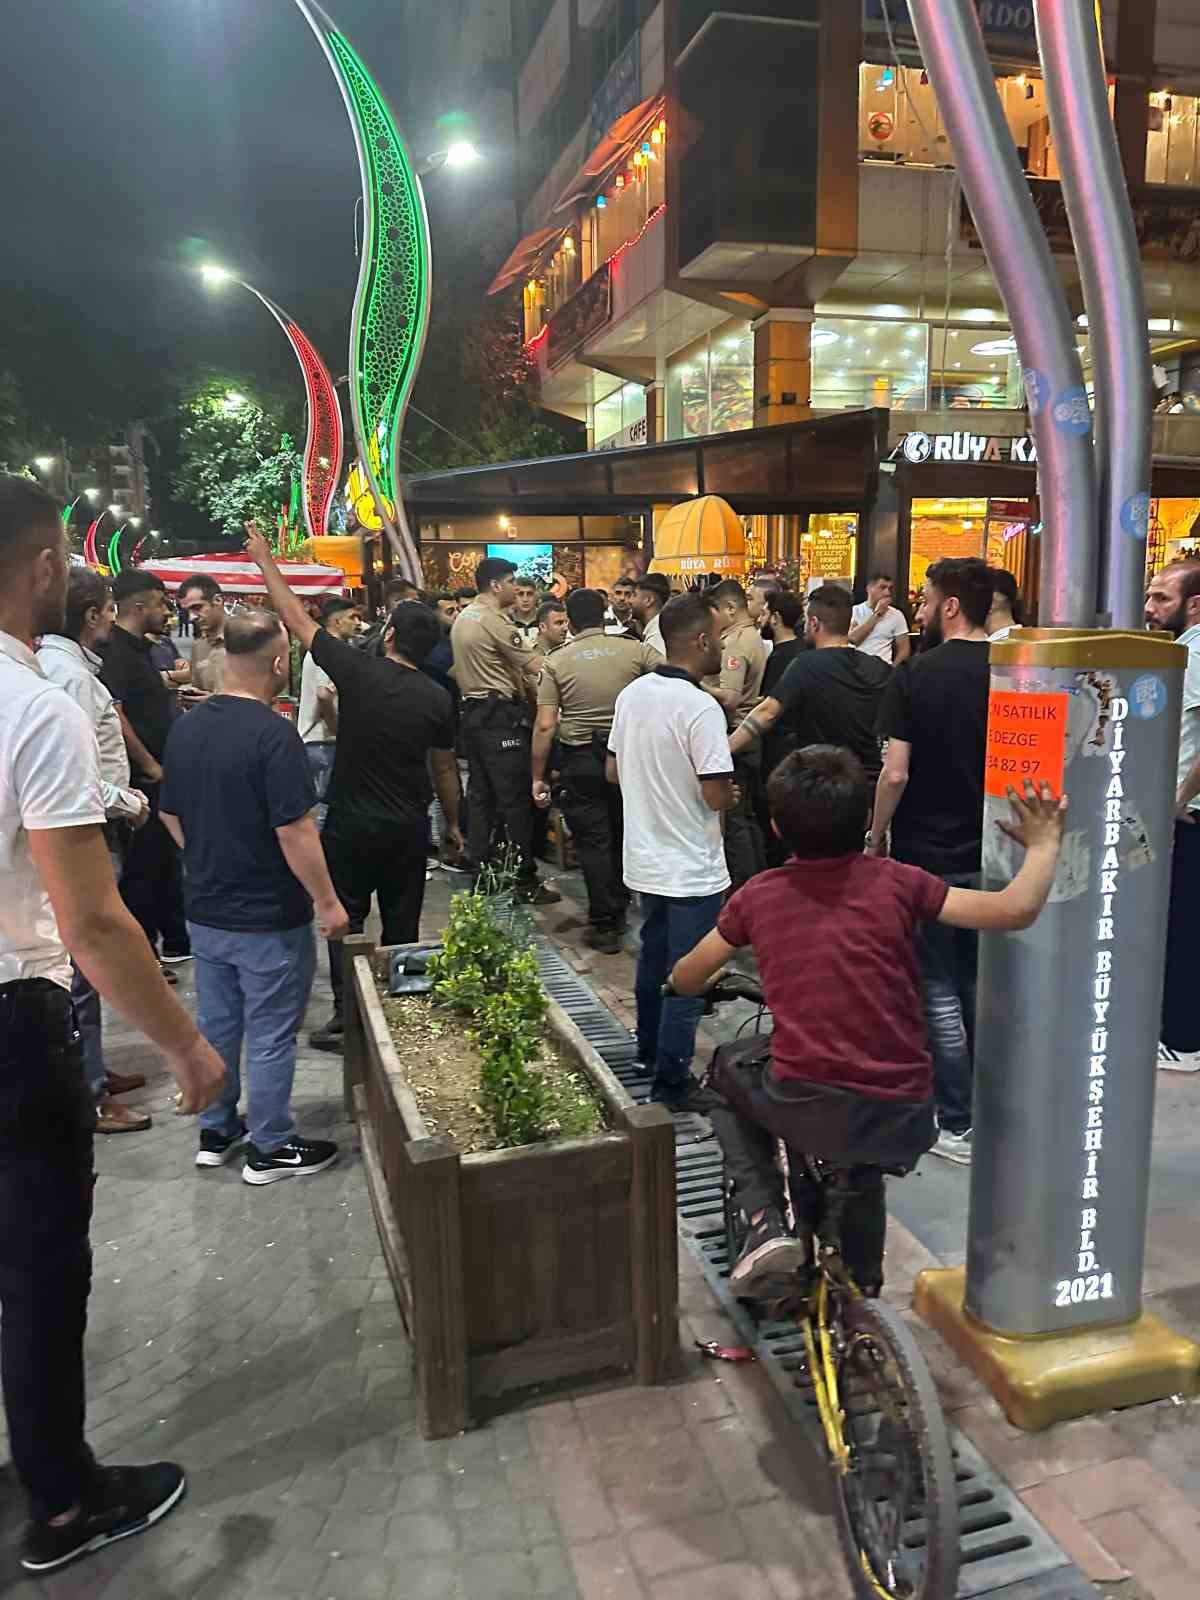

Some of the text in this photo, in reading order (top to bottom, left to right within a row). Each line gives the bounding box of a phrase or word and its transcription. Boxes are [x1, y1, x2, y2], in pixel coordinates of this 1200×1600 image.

[934, 431, 1001, 461] RÜYA
[1002, 703, 1057, 720] SATILIK
[1000, 758, 1017, 772] 82
[1021, 760, 1041, 774] 97
[1077, 697, 1129, 1273] DİYARBAKIR BÜYÜKŞEHİR BLD.
[1055, 1273, 1114, 1307] 2021
